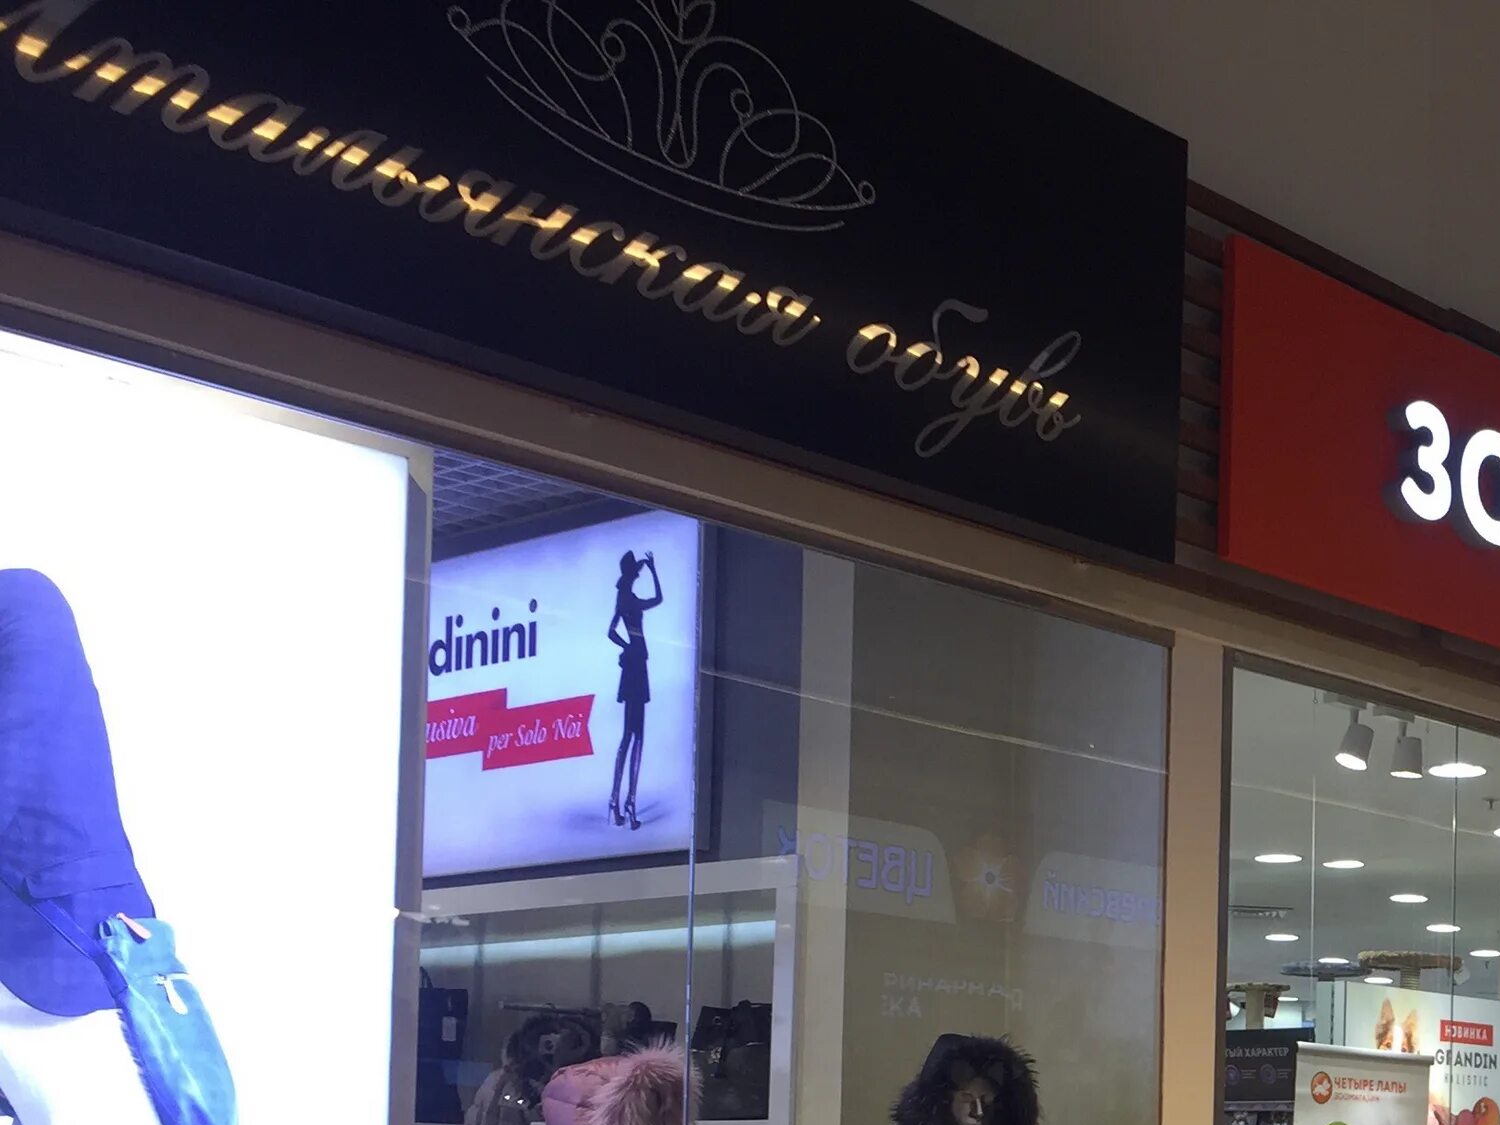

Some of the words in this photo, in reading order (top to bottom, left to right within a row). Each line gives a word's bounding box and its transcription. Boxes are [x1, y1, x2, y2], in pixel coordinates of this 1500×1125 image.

[847, 299, 1081, 457] обувь
[487, 730, 513, 758] per
[515, 719, 547, 747] Solo
[1444, 1025, 1488, 1041] НОВИНКА
[1244, 1046, 1290, 1058] ХАРАКТЕР
[1334, 1077, 1375, 1092] ЧЕТЫРЕ
[1376, 1080, 1407, 1094] ЛАПЫ
